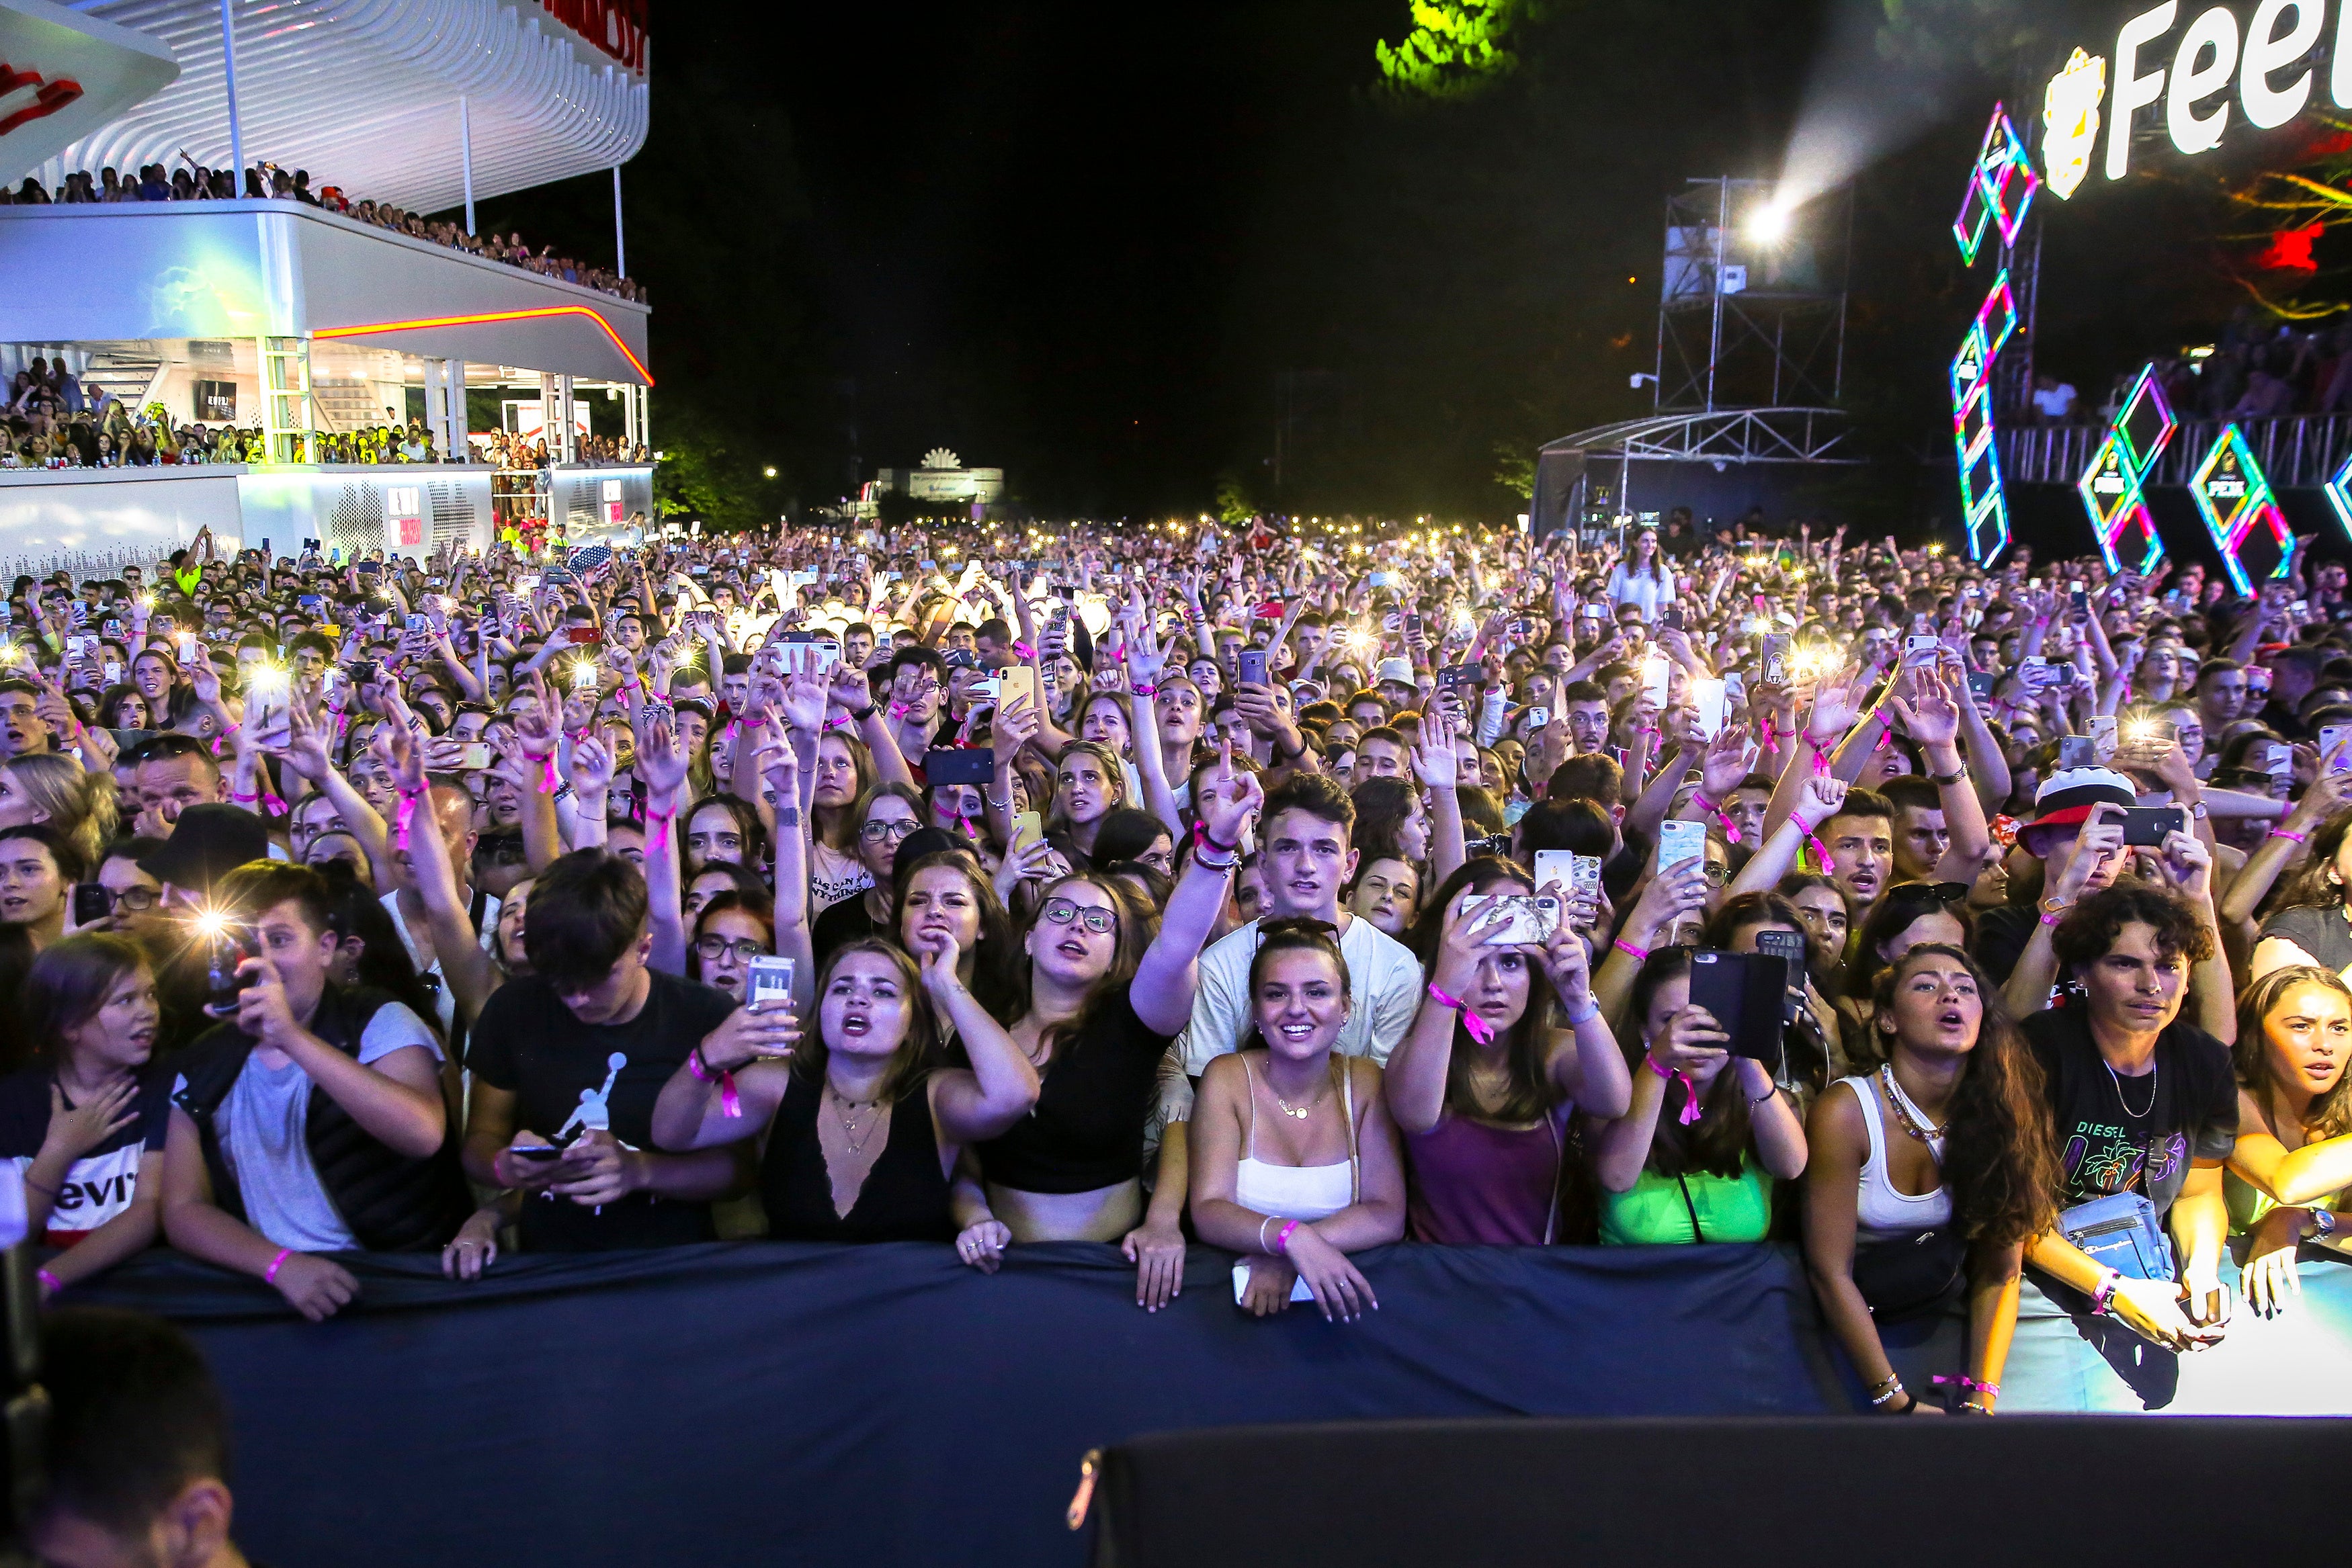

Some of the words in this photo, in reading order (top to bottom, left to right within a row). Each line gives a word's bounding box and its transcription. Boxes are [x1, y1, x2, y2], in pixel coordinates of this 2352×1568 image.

[833, 877, 853, 891] CAN
[812, 885, 862, 902] NYTHING
[2076, 1121, 2126, 1138] DIESEL
[2084, 1240, 2134, 1255] Champion
